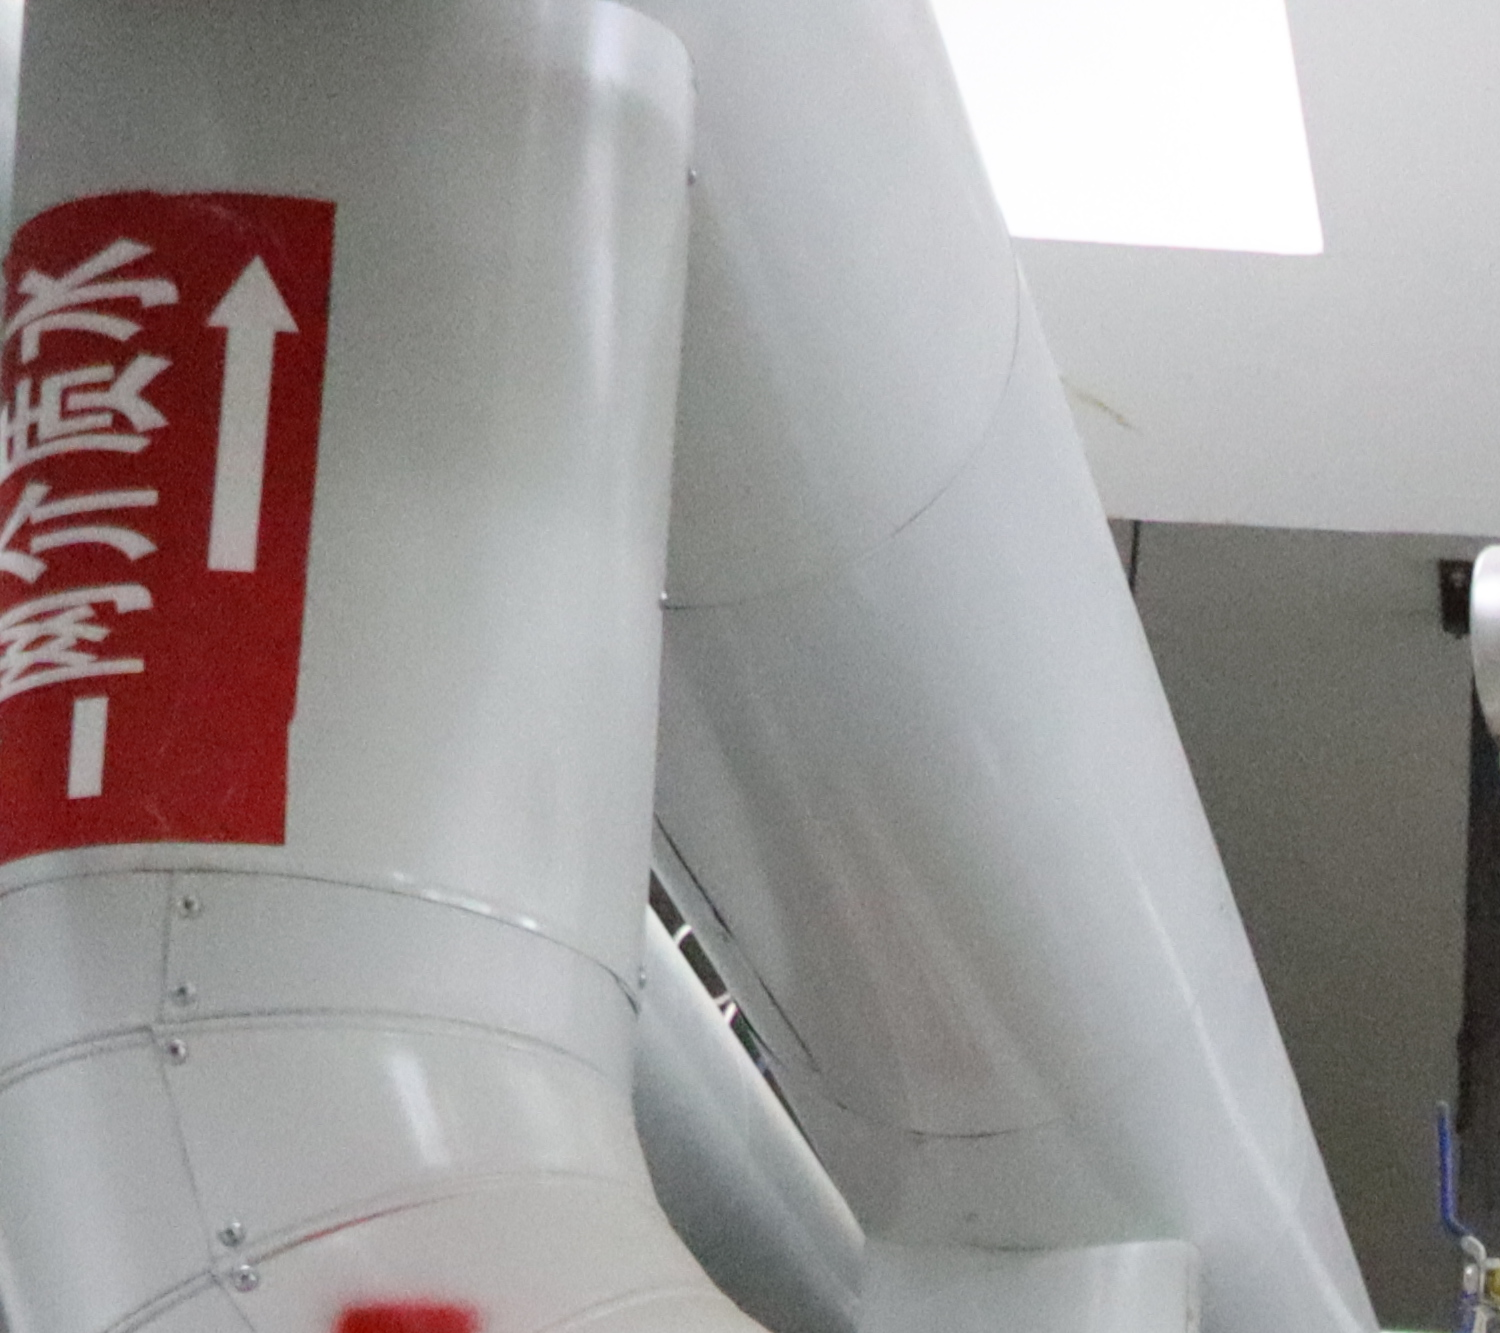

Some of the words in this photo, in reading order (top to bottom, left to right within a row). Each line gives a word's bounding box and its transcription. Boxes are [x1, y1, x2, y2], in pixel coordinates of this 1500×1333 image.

[0, 237, 180, 800] 一网介质水
